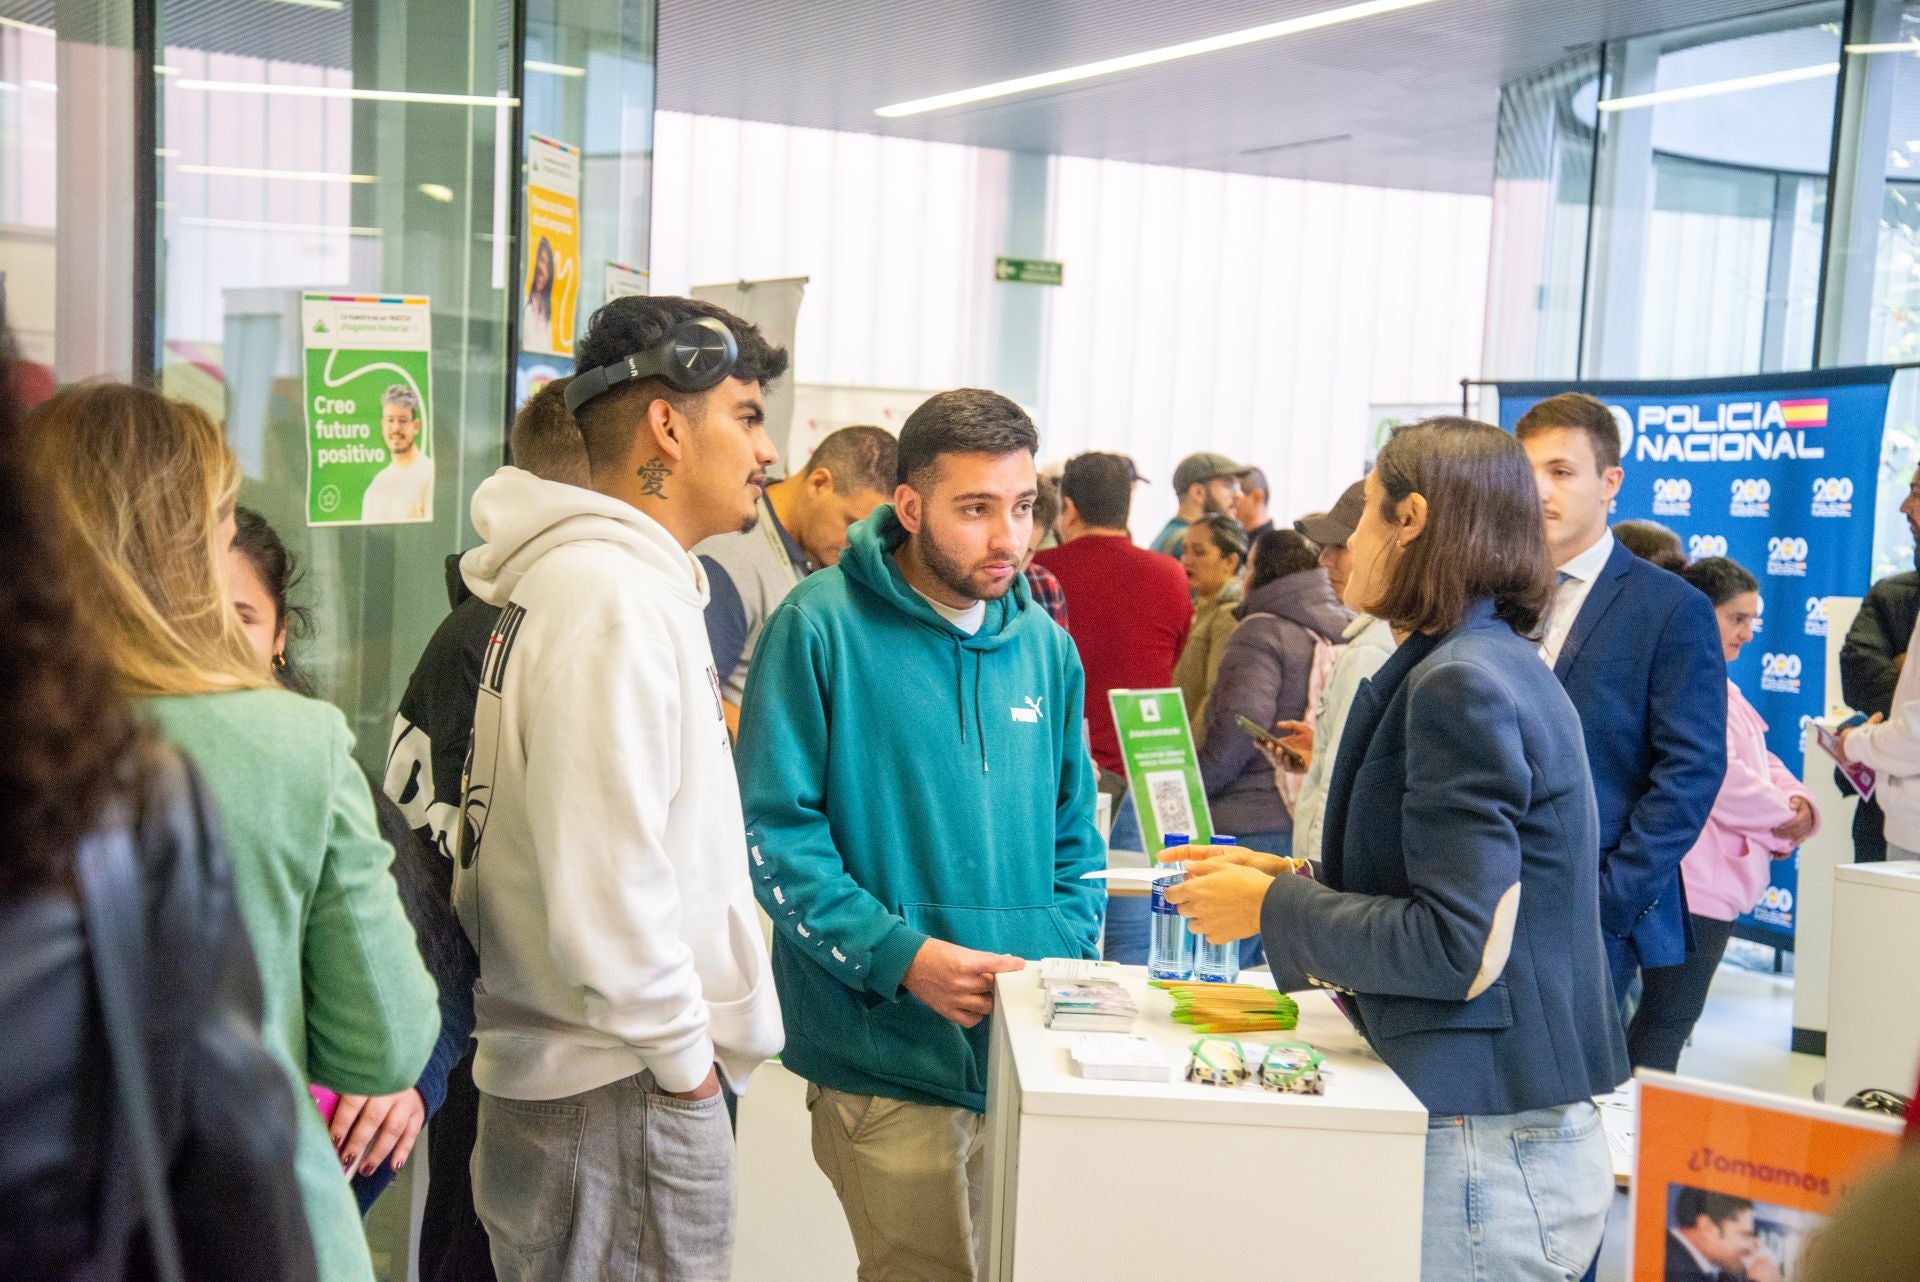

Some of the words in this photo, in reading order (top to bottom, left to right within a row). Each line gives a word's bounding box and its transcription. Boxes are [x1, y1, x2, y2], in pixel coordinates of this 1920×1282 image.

[314, 395, 356, 414] Creo
[316, 419, 370, 439] futuro
[1638, 401, 1787, 434] POLICIA
[318, 443, 385, 468] positivo
[1636, 430, 1825, 462] NACIONAL
[637, 456, 673, 500] 愛
[1653, 478, 1692, 502] 200
[1730, 478, 1771, 503] 200
[1812, 477, 1854, 503] 200
[1767, 537, 1808, 562] 200
[1761, 652, 1802, 679] 200
[1688, 1146, 1831, 1195] ¿Tomamos
